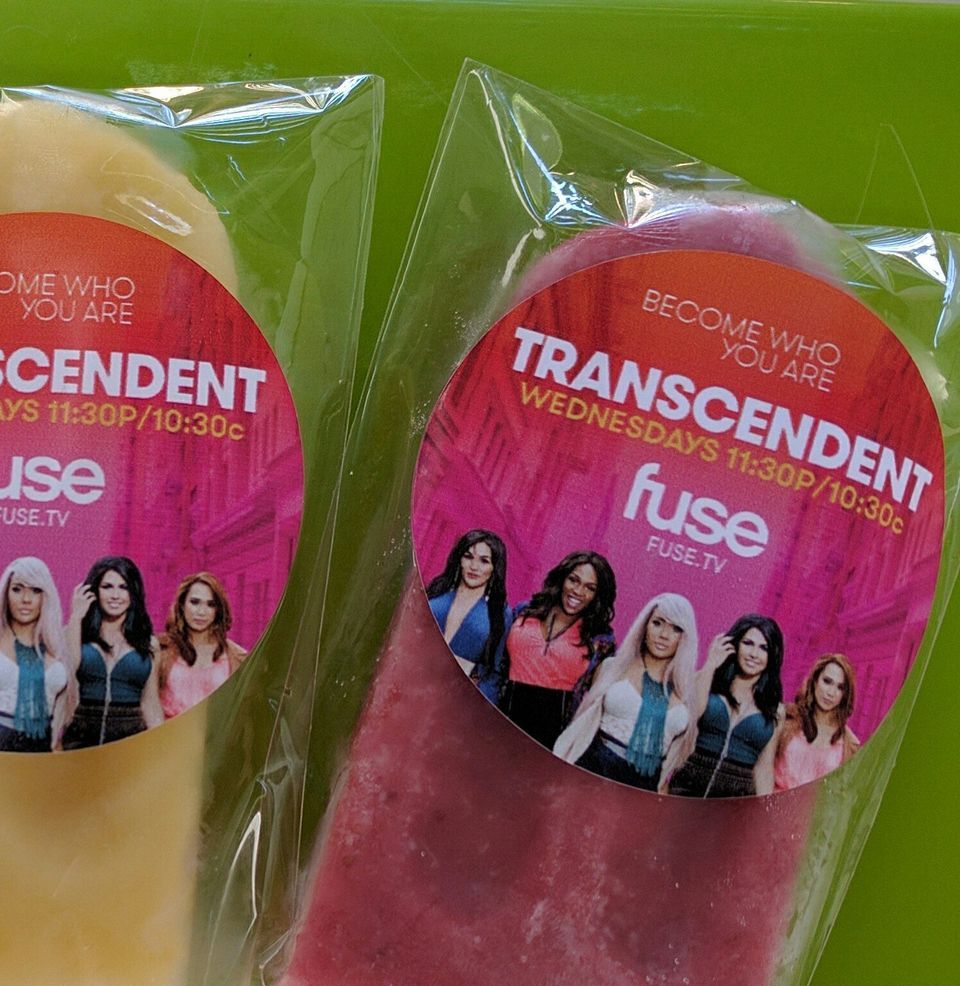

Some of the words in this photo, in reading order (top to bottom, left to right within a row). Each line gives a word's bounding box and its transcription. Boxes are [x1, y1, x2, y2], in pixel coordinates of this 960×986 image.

[21, 298, 79, 322] YOU
[83, 300, 133, 325] ARE
[64, 274, 135, 300] WHO
[642, 289, 763, 344] BECOME
[769, 326, 841, 366] WHO
[719, 337, 777, 375] YOU
[782, 358, 836, 393] ARE
[512, 326, 933, 512] TRANSCENDENT
[519, 381, 718, 462] WEDNESDAYS
[623, 462, 768, 558] fuse
[646, 536, 727, 574] FUSE.TV
